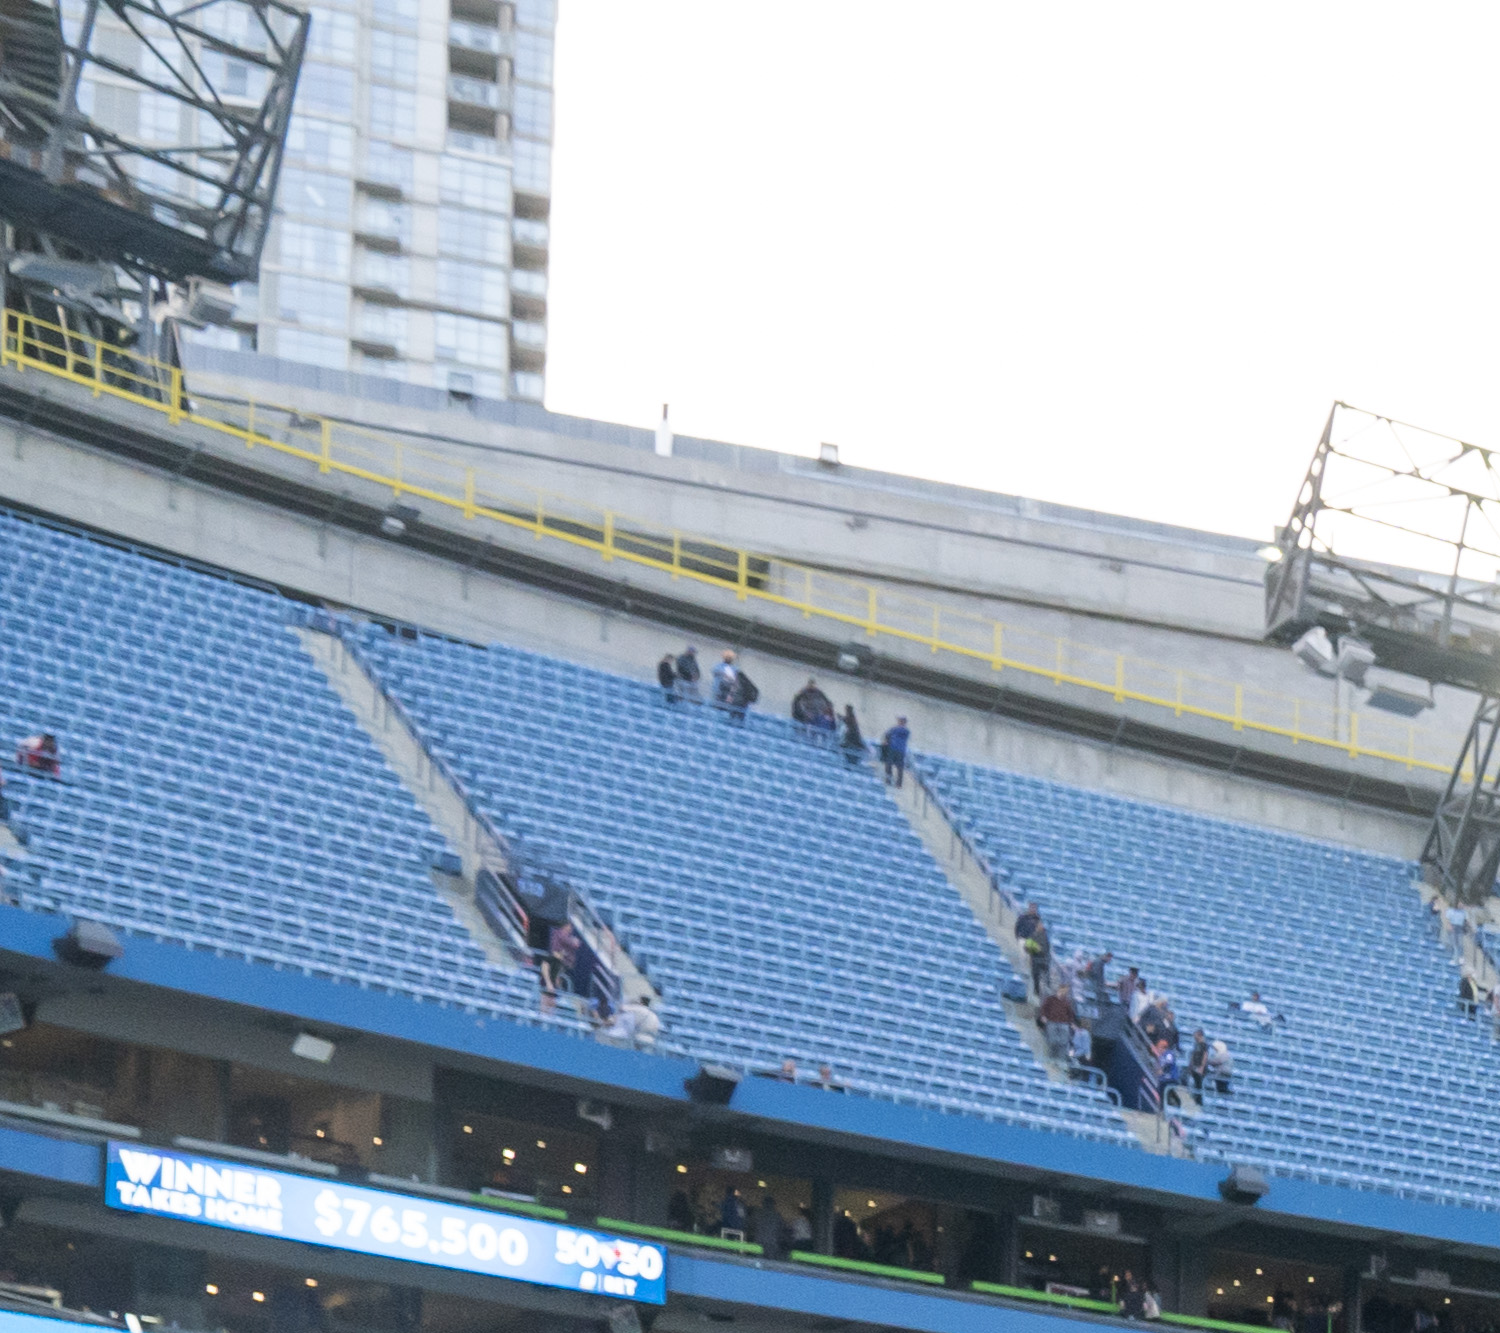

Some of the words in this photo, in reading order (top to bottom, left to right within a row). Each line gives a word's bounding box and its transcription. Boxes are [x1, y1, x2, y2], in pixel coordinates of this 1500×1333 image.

[117, 1181, 201, 1218] TAKES
[205, 1199, 283, 1231] HOME
[119, 1150, 282, 1208] WINNER
[315, 1188, 528, 1267] $765,500
